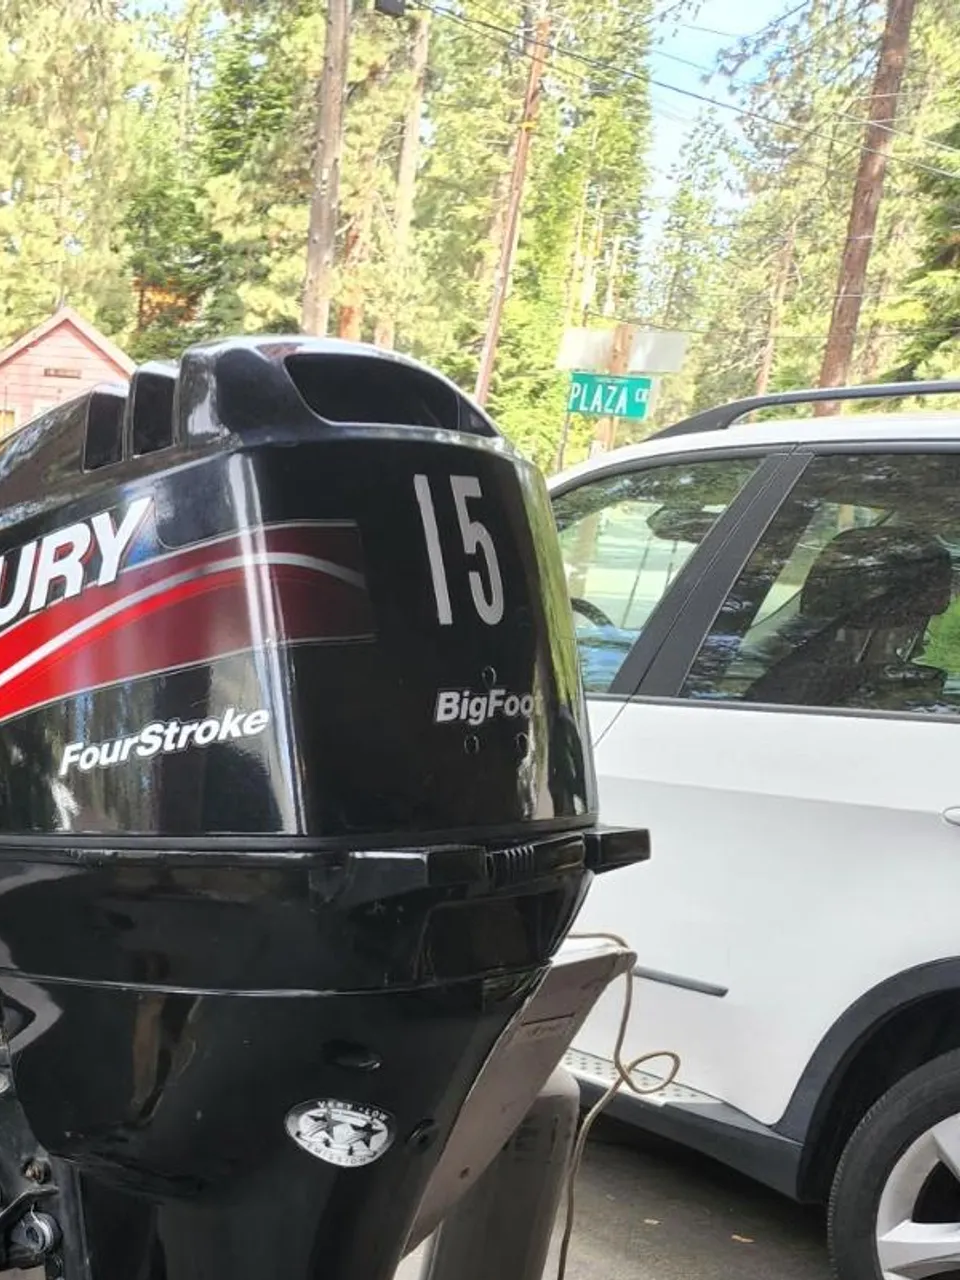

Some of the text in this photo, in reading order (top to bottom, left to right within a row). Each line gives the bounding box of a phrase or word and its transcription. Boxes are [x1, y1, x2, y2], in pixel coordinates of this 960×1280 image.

[568, 382, 628, 415] PLAZA
[413, 474, 504, 625] 15
[58, 707, 270, 776] FourStroke
